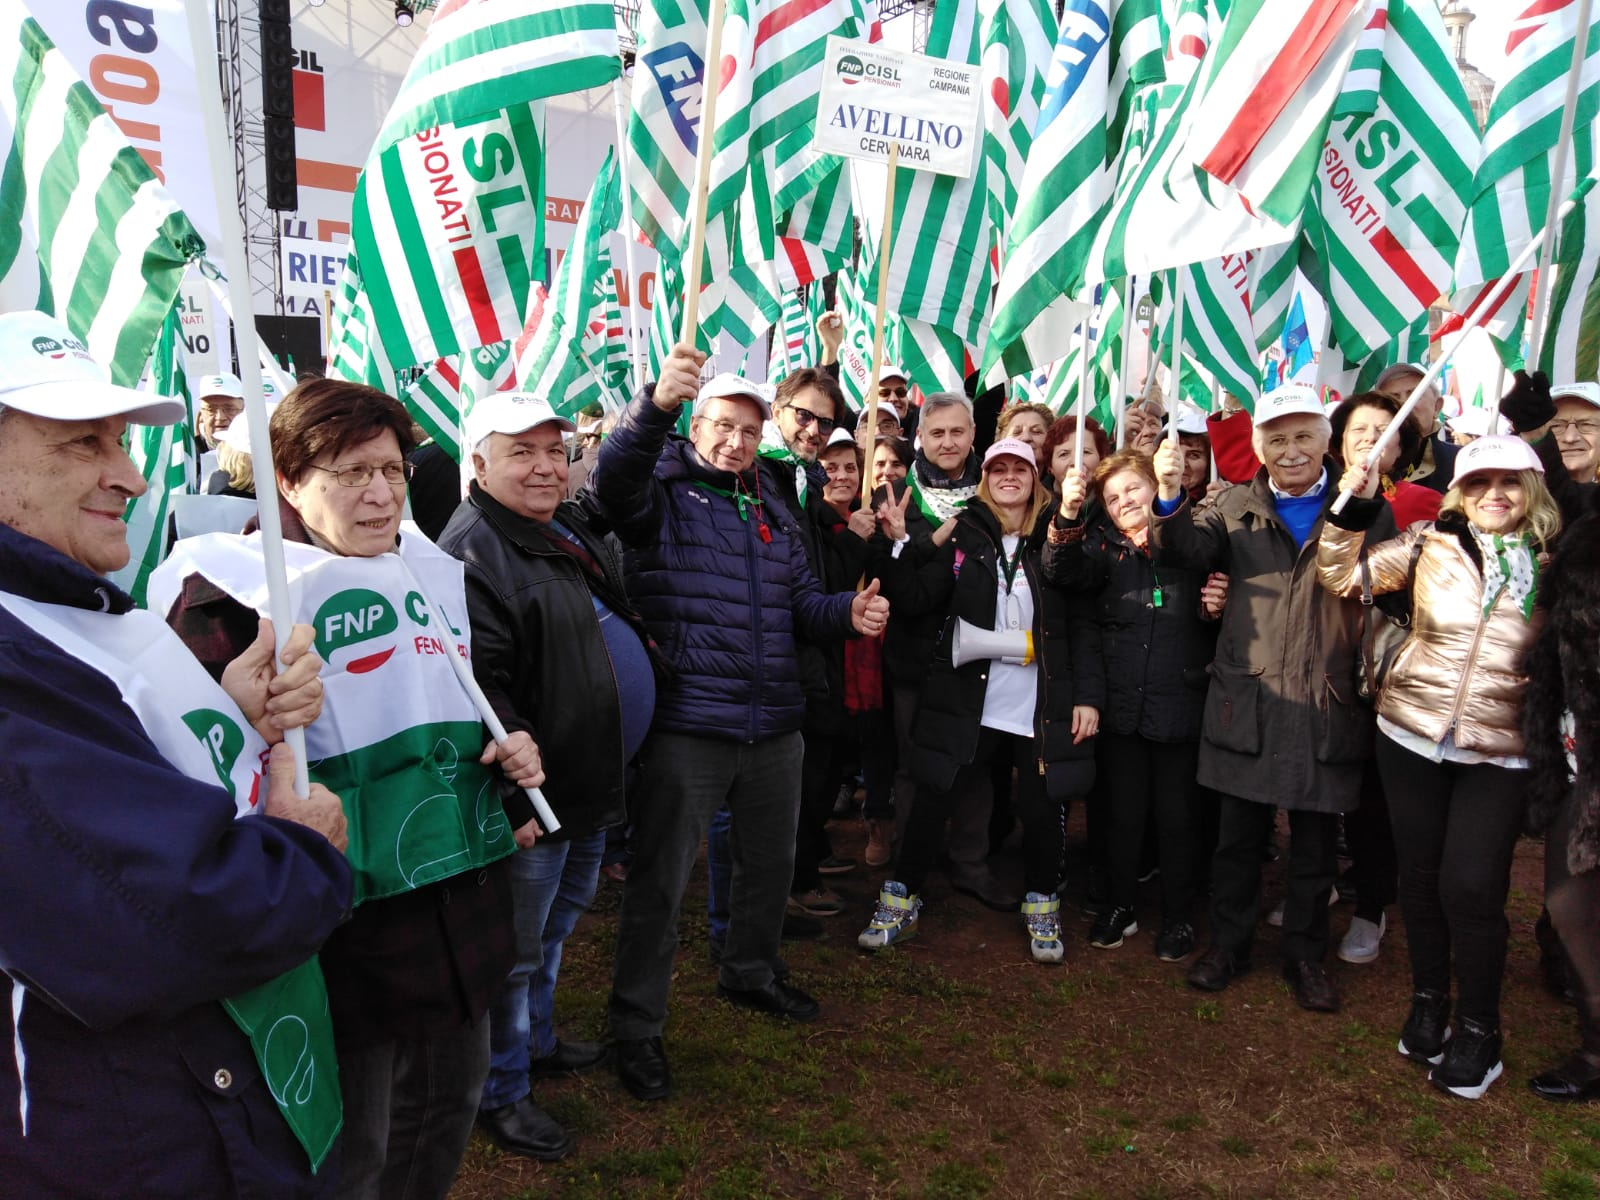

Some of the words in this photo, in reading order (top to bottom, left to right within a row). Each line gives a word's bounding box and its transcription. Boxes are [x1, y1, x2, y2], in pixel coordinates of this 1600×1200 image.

[840, 61, 862, 73] FNP
[865, 63, 902, 81] CISL
[933, 67, 970, 83] REGIONE
[863, 75, 901, 89] PENSIONATI
[929, 79, 970, 96] CAMPANIA
[829, 103, 963, 150] AVELLINO
[860, 137, 930, 163] CERVNARA
[36, 341, 57, 351] FNP
[325, 604, 384, 643] FNP
